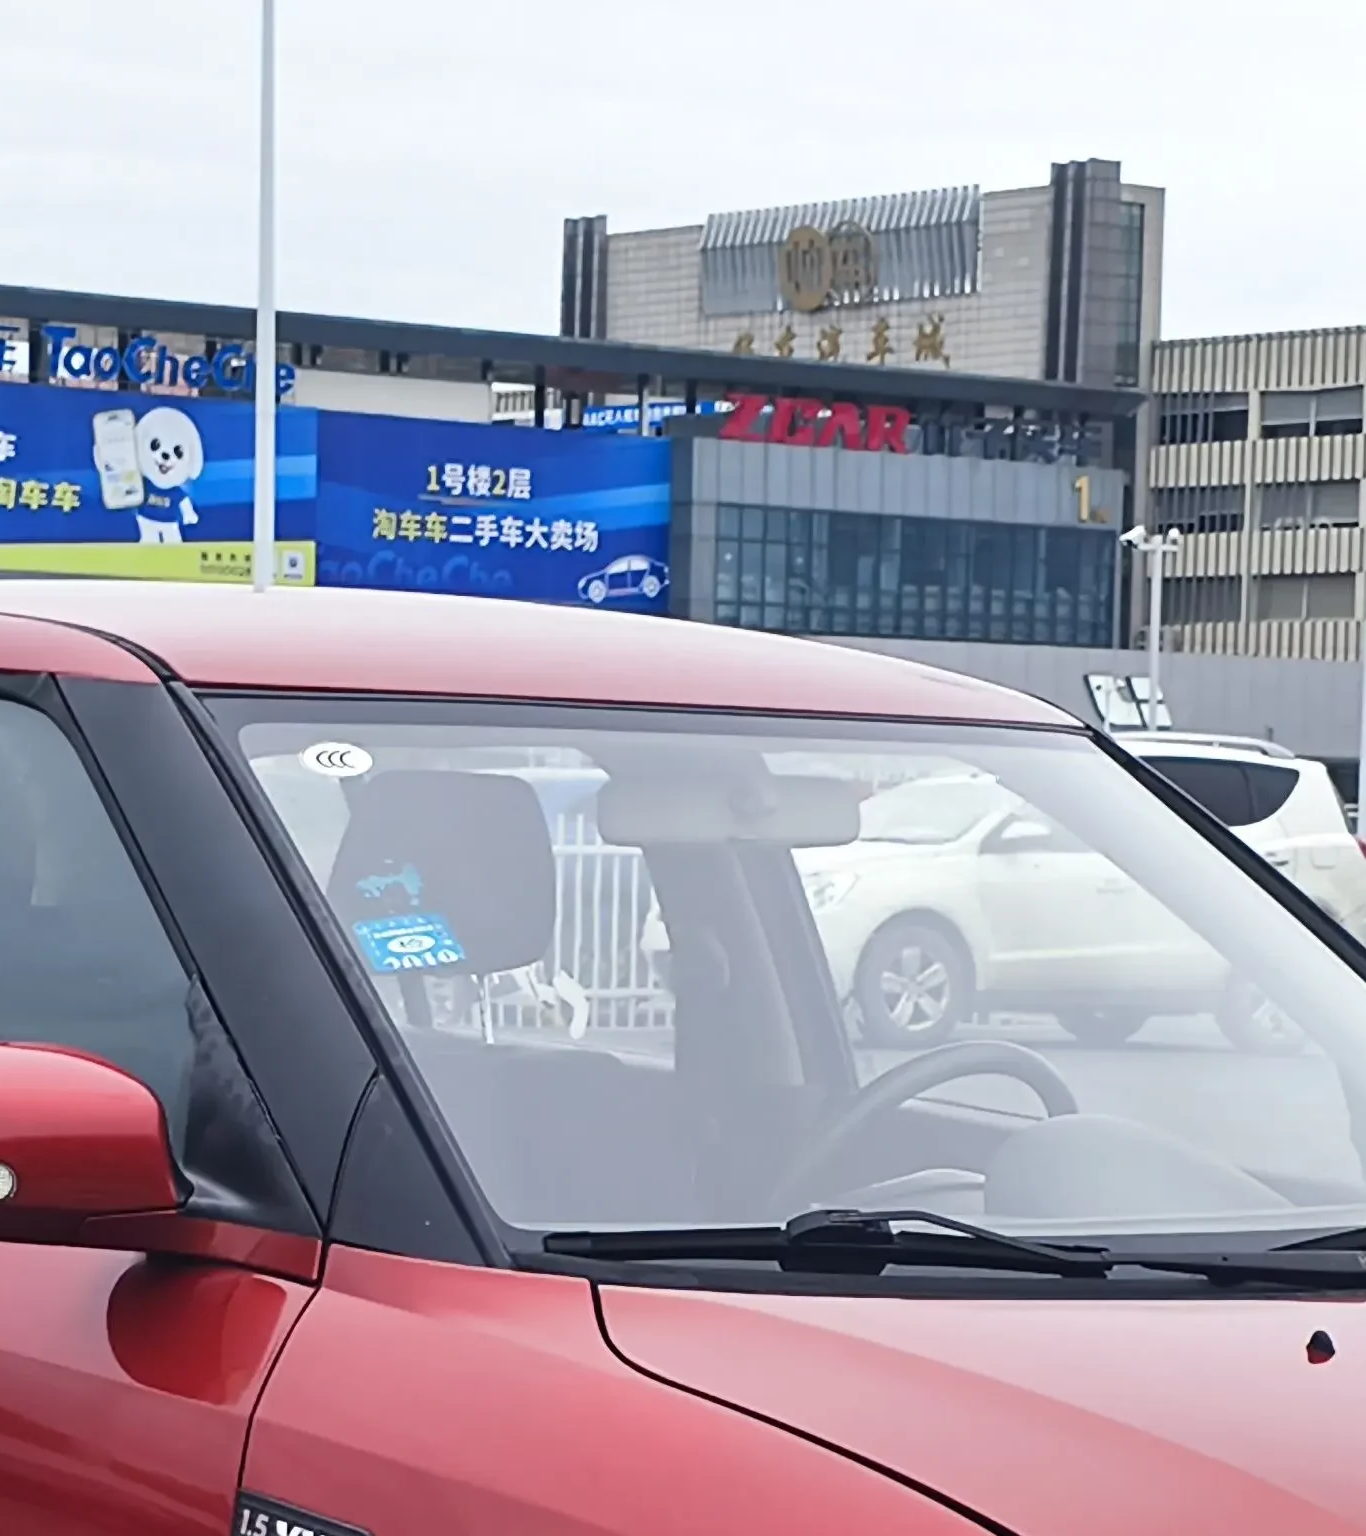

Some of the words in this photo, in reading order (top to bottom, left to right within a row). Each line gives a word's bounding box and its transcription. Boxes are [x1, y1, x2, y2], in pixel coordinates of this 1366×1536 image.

[425, 462, 532, 500] 1号楼2层
[1074, 475, 1092, 523] 1
[372, 507, 600, 553] 淘车车二手车大卖场
